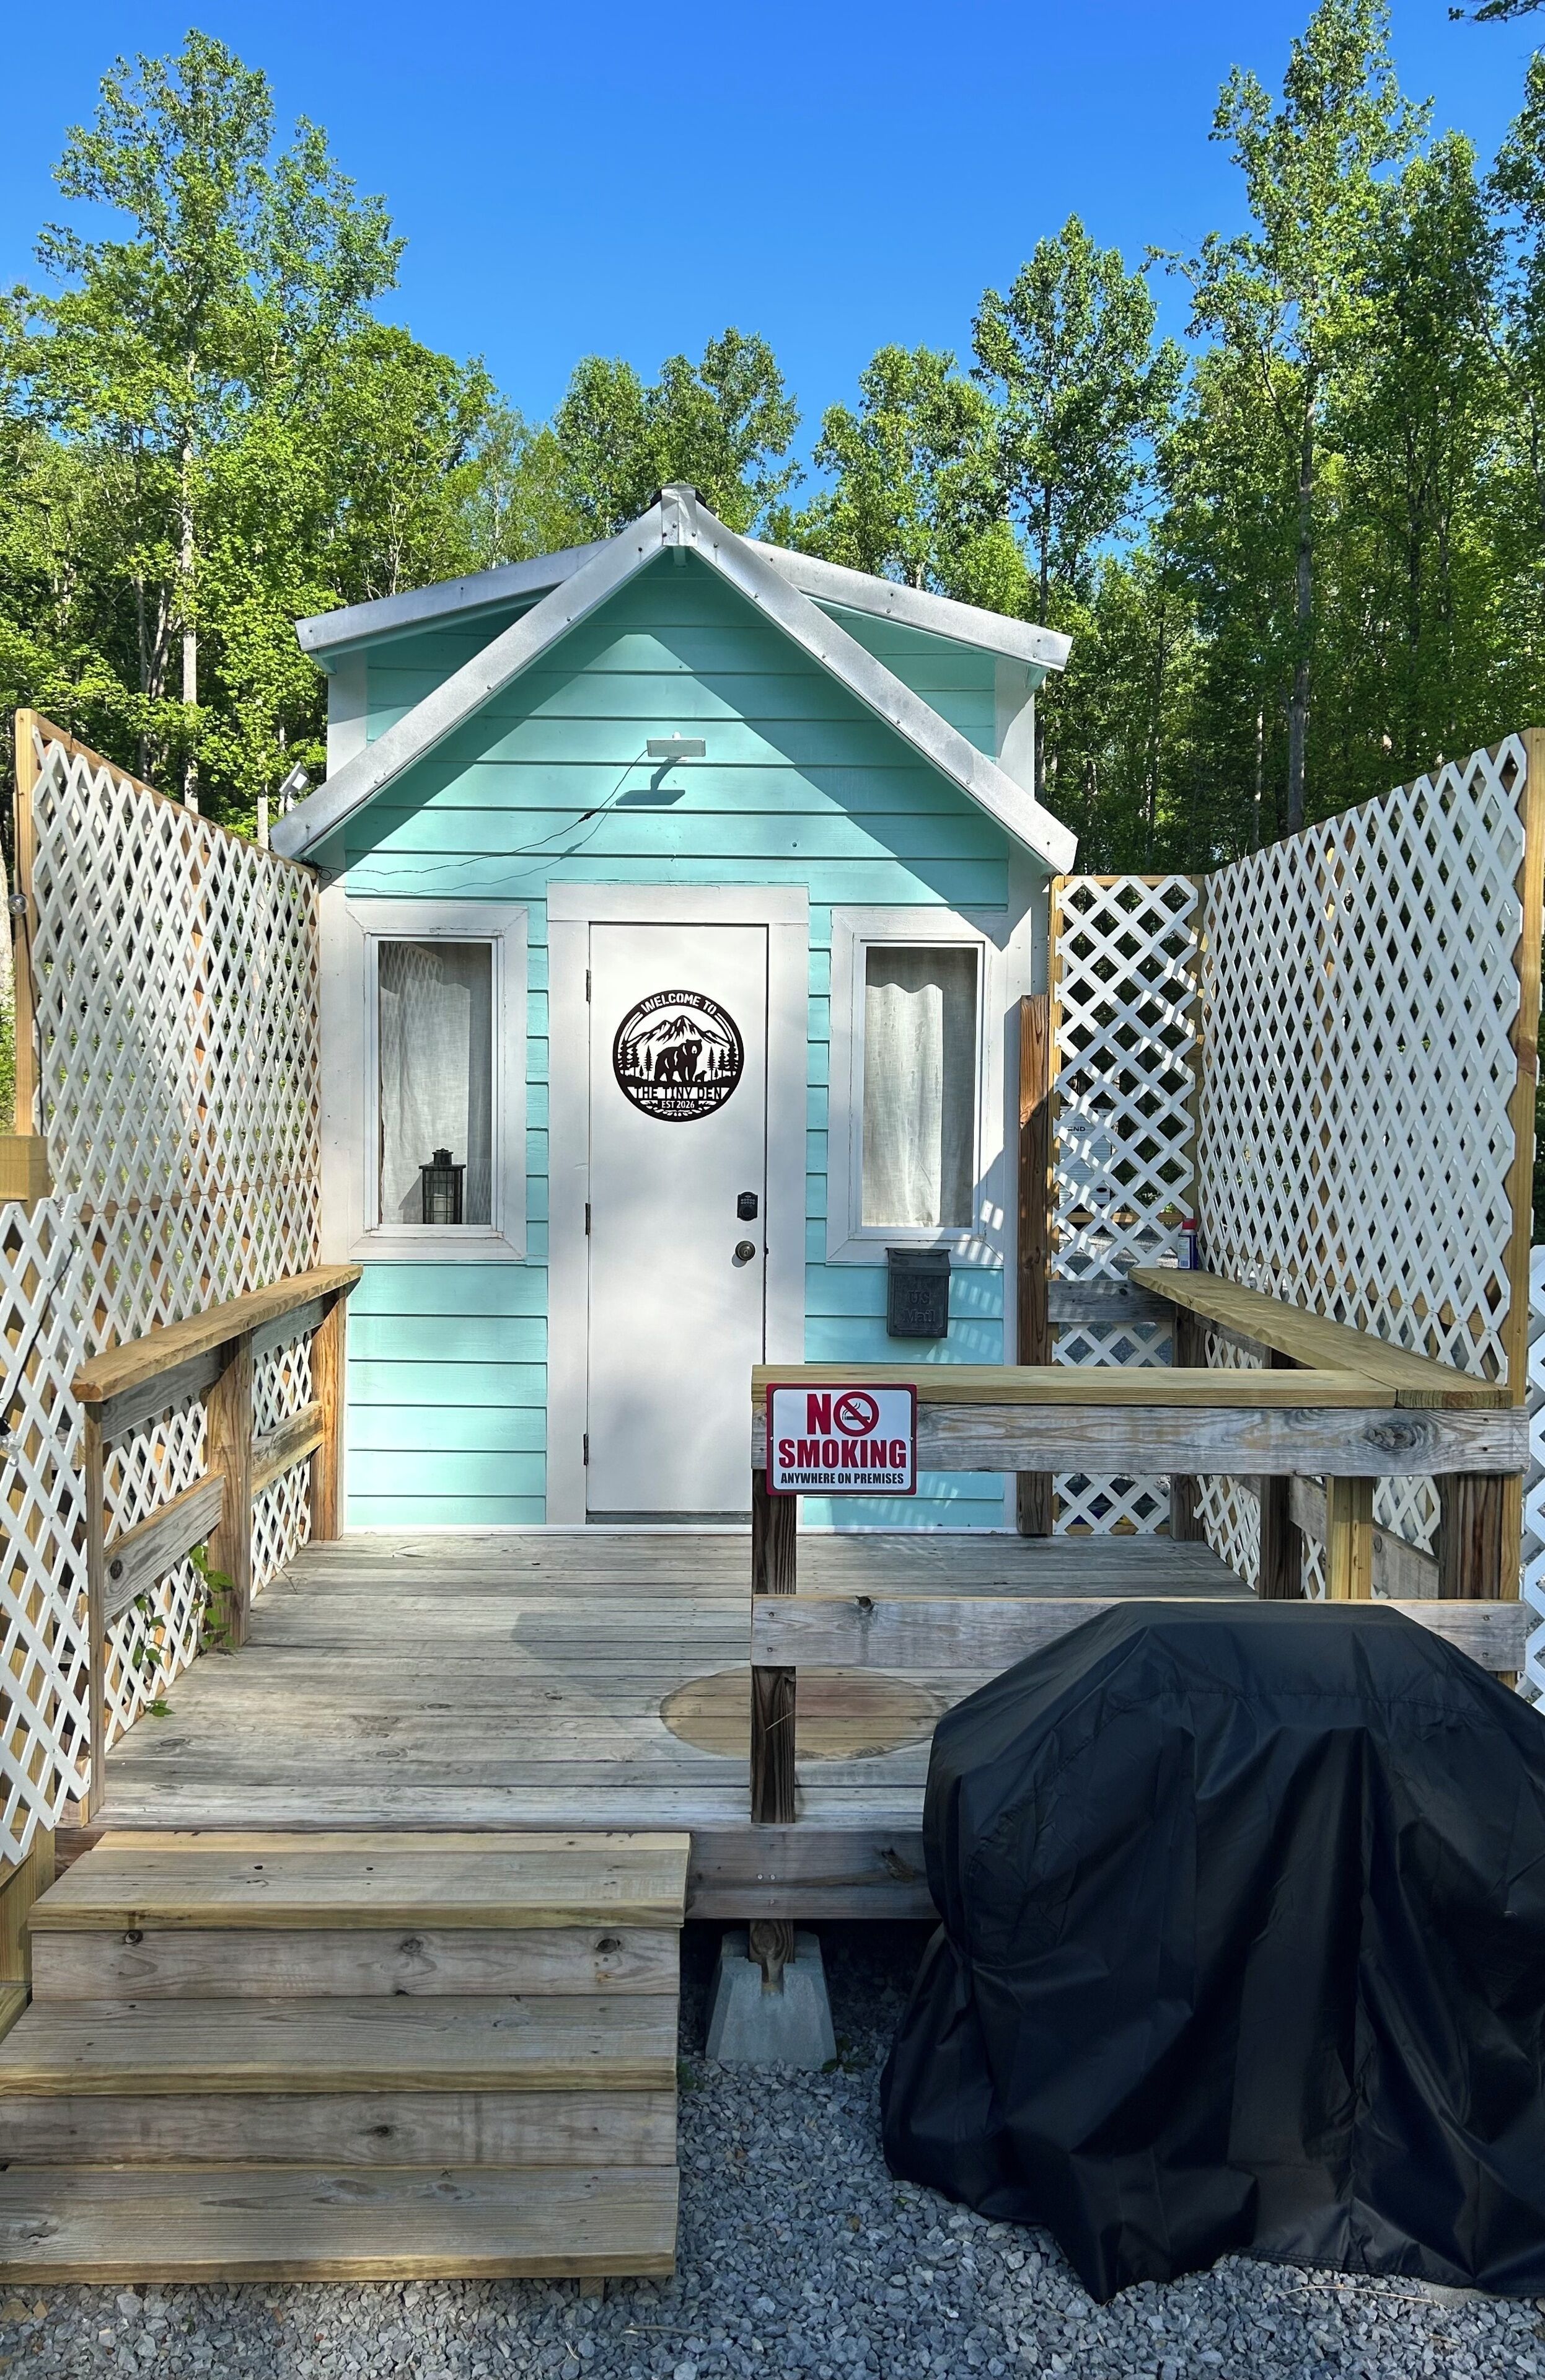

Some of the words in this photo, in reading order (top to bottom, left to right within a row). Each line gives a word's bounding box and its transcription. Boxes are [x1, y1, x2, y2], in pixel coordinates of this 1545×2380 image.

[640, 993, 701, 1013] WELCOME
[703, 1000, 717, 1015] TO
[633, 1086, 658, 1099] THE
[662, 1086, 693, 1100] TINY
[697, 1086, 722, 1100] DEN
[661, 1100, 675, 1108] EST
[676, 1100, 695, 1108] 2026
[907, 1290, 931, 1305] US
[902, 1308, 935, 1324] Mail
[778, 1439, 907, 1468] SMOKING
[780, 1473, 835, 1484] ANYWHERE
[838, 1473, 852, 1484] ON
[854, 1473, 904, 1484] PREMISES
